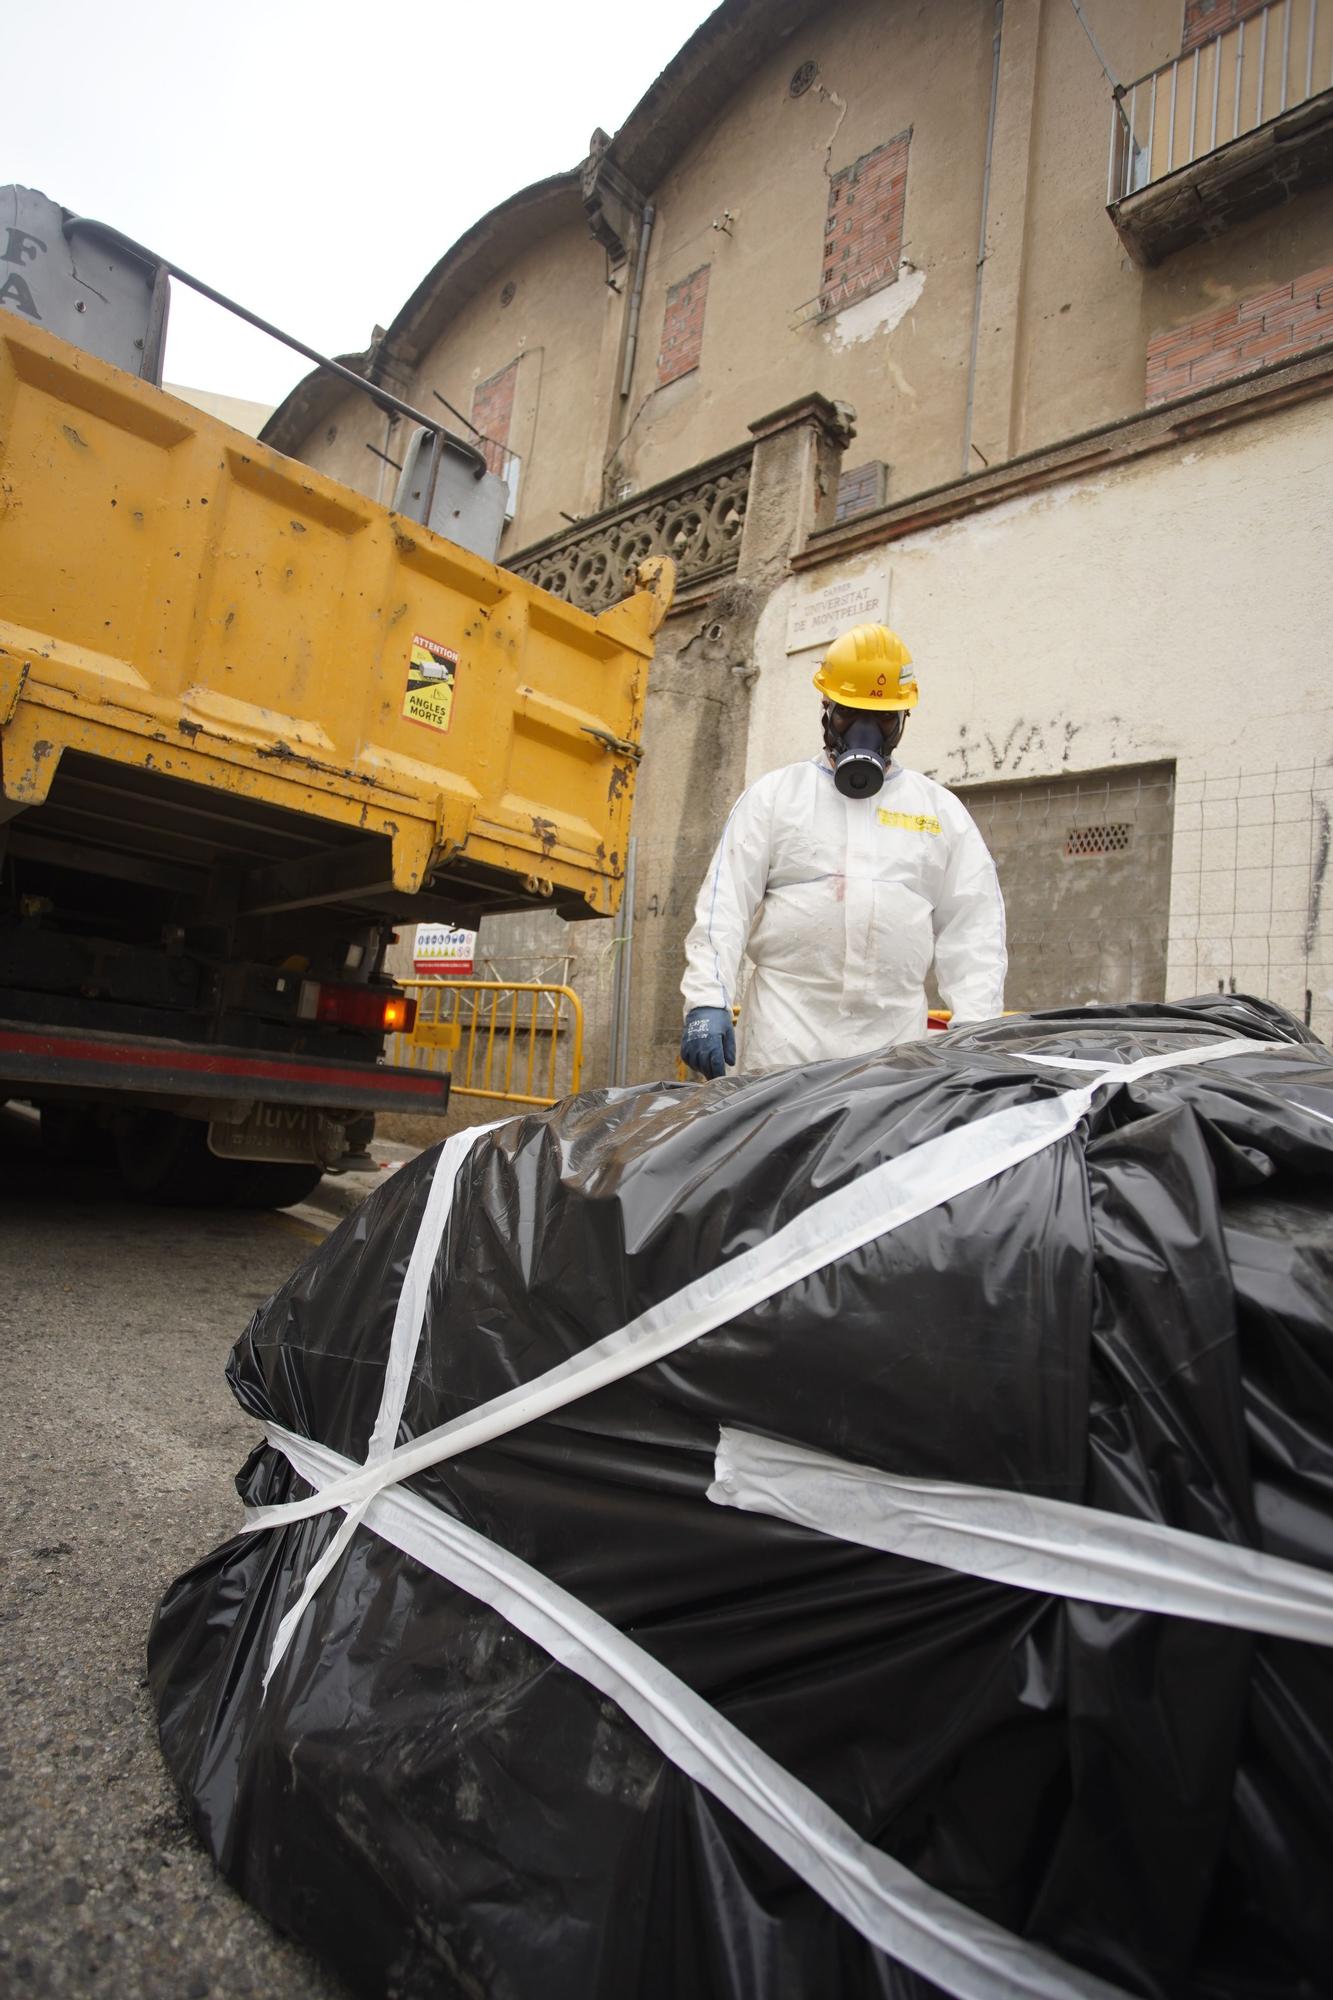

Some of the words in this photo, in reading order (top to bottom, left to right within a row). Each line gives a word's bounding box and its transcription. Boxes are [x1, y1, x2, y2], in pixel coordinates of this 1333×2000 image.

[823, 582, 852, 597] CARRER
[804, 587, 871, 617] UNIVERSITAT
[793, 620, 807, 633] DE
[413, 635, 459, 661] ATTENTION
[869, 689, 884, 698] AG
[409, 695, 446, 716] ANGLES
[409, 706, 443, 725] MORTS
